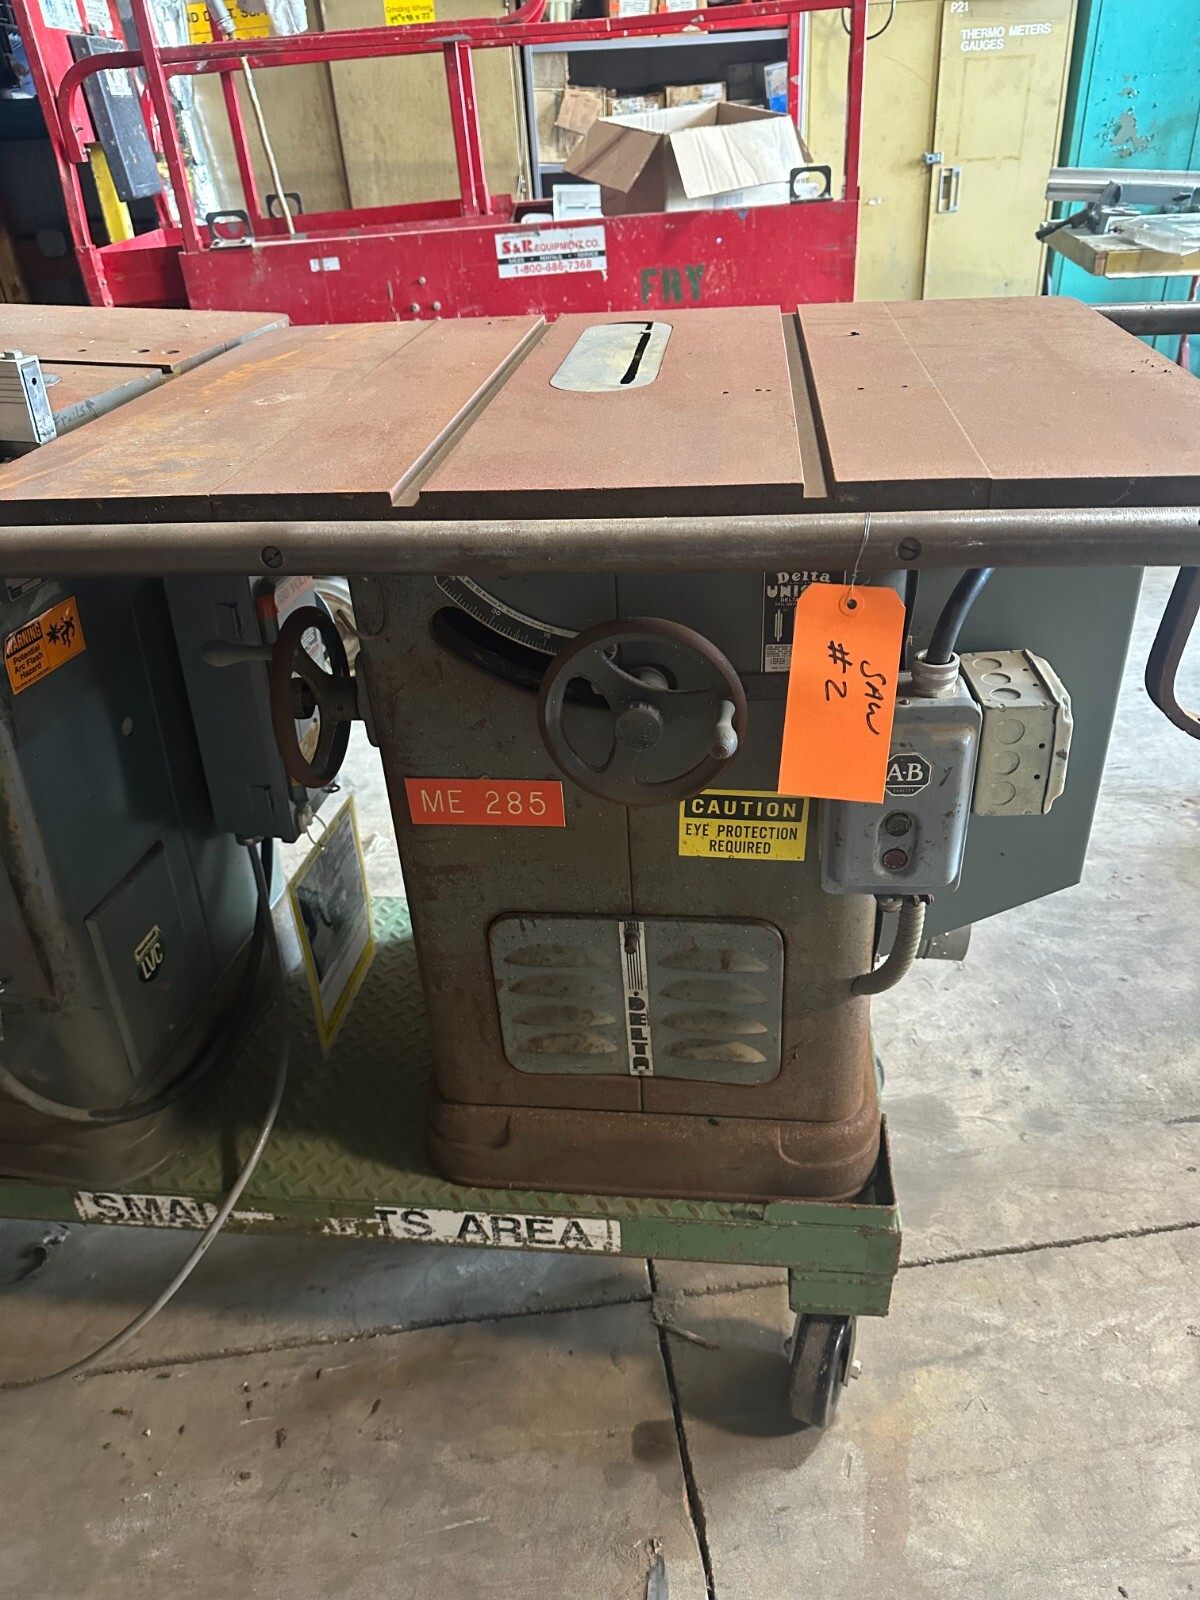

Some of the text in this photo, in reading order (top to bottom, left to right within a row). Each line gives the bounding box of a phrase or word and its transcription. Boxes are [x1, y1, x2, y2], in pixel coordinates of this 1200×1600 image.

[950, 1, 969, 13] P21
[960, 23, 1052, 40] THERMO METERS
[960, 39, 1005, 52] GAUGES
[534, 240, 584, 253] EQUIPMENT
[641, 264, 705, 304] FRY
[776, 570, 831, 585] Delta
[6, 622, 43, 655] WARNING
[12, 643, 41, 665] Potential
[14, 652, 44, 674] Arc Flash
[20, 662, 42, 679] Hazard
[420, 789, 547, 816] ME 285
[690, 797, 797, 818] CAUTION
[685, 822, 799, 841] EYE PROTECTION
[708, 839, 772, 855] REQUIRED
[456, 1212, 594, 1248] AREA
